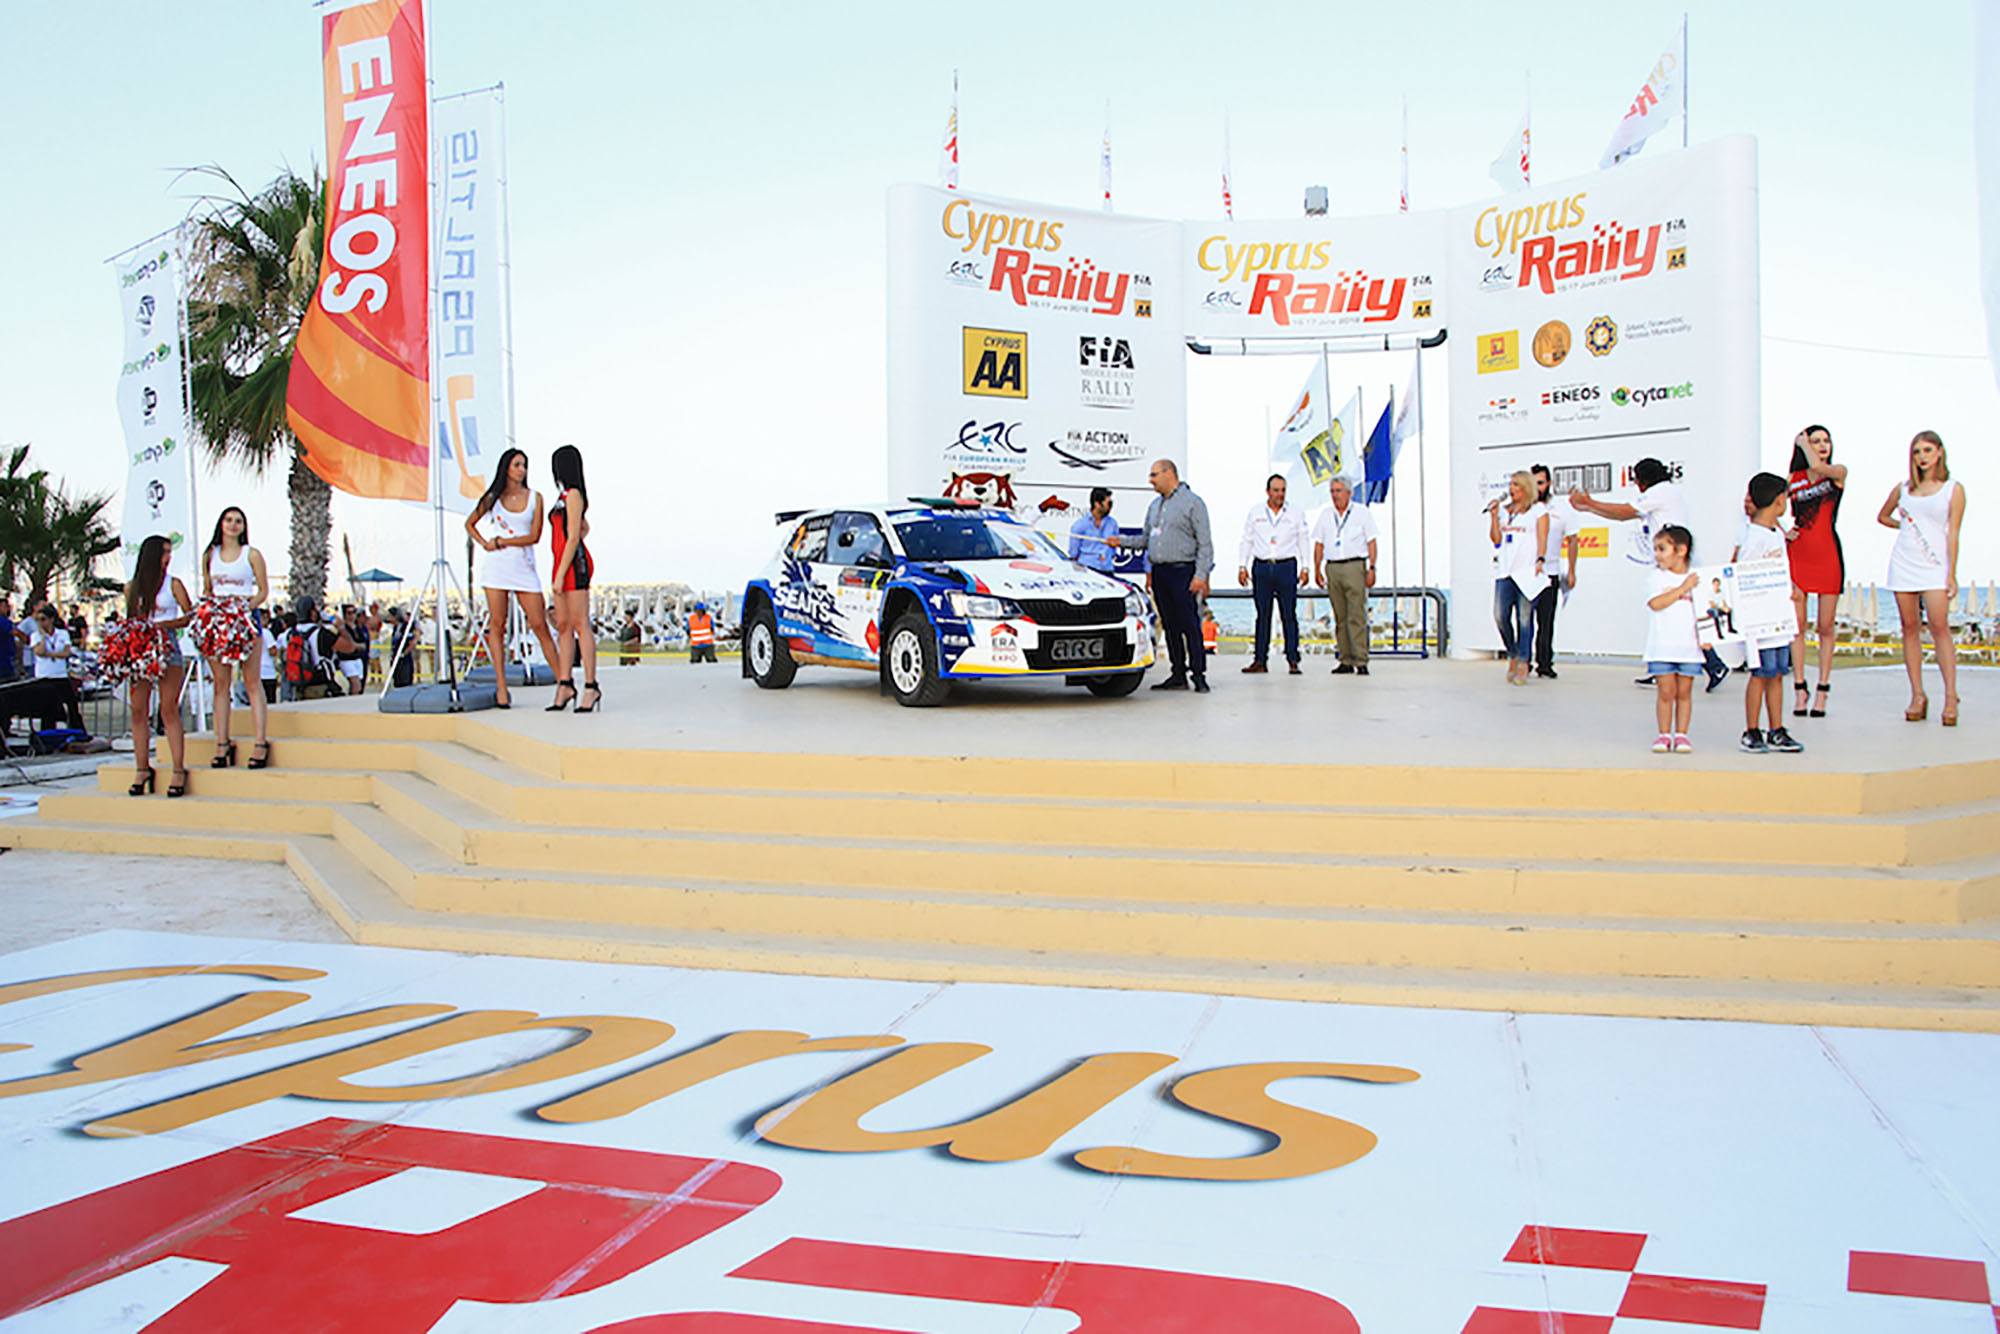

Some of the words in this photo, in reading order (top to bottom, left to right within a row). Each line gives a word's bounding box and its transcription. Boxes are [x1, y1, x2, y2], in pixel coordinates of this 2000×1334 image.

[319, 35, 398, 315] ENEOS
[942, 199, 1064, 255] Cyprus
[1474, 192, 1587, 258] Cyprus
[1198, 235, 1332, 283] Cyprus
[1518, 220, 1662, 296] Rally
[1668, 252, 1685, 269] AA
[989, 246, 1130, 316] Rally
[1247, 269, 1408, 326] Rally
[1135, 303, 1151, 317] AA
[1415, 304, 1431, 317] AA
[983, 336, 1022, 350] CYPRUS
[970, 350, 1021, 391] AA
[1081, 378, 1134, 397] RALLY
[1552, 386, 1600, 404] ENEOS
[1632, 381, 1694, 407] cytanet
[1085, 431, 1129, 444] ACTION
[959, 455, 1001, 463] EUROPEAN
[1082, 445, 1109, 456] ROAD
[1110, 445, 1146, 456] SAFETY
[991, 637, 1017, 648] ERA
[991, 654, 1018, 663] EXPO
